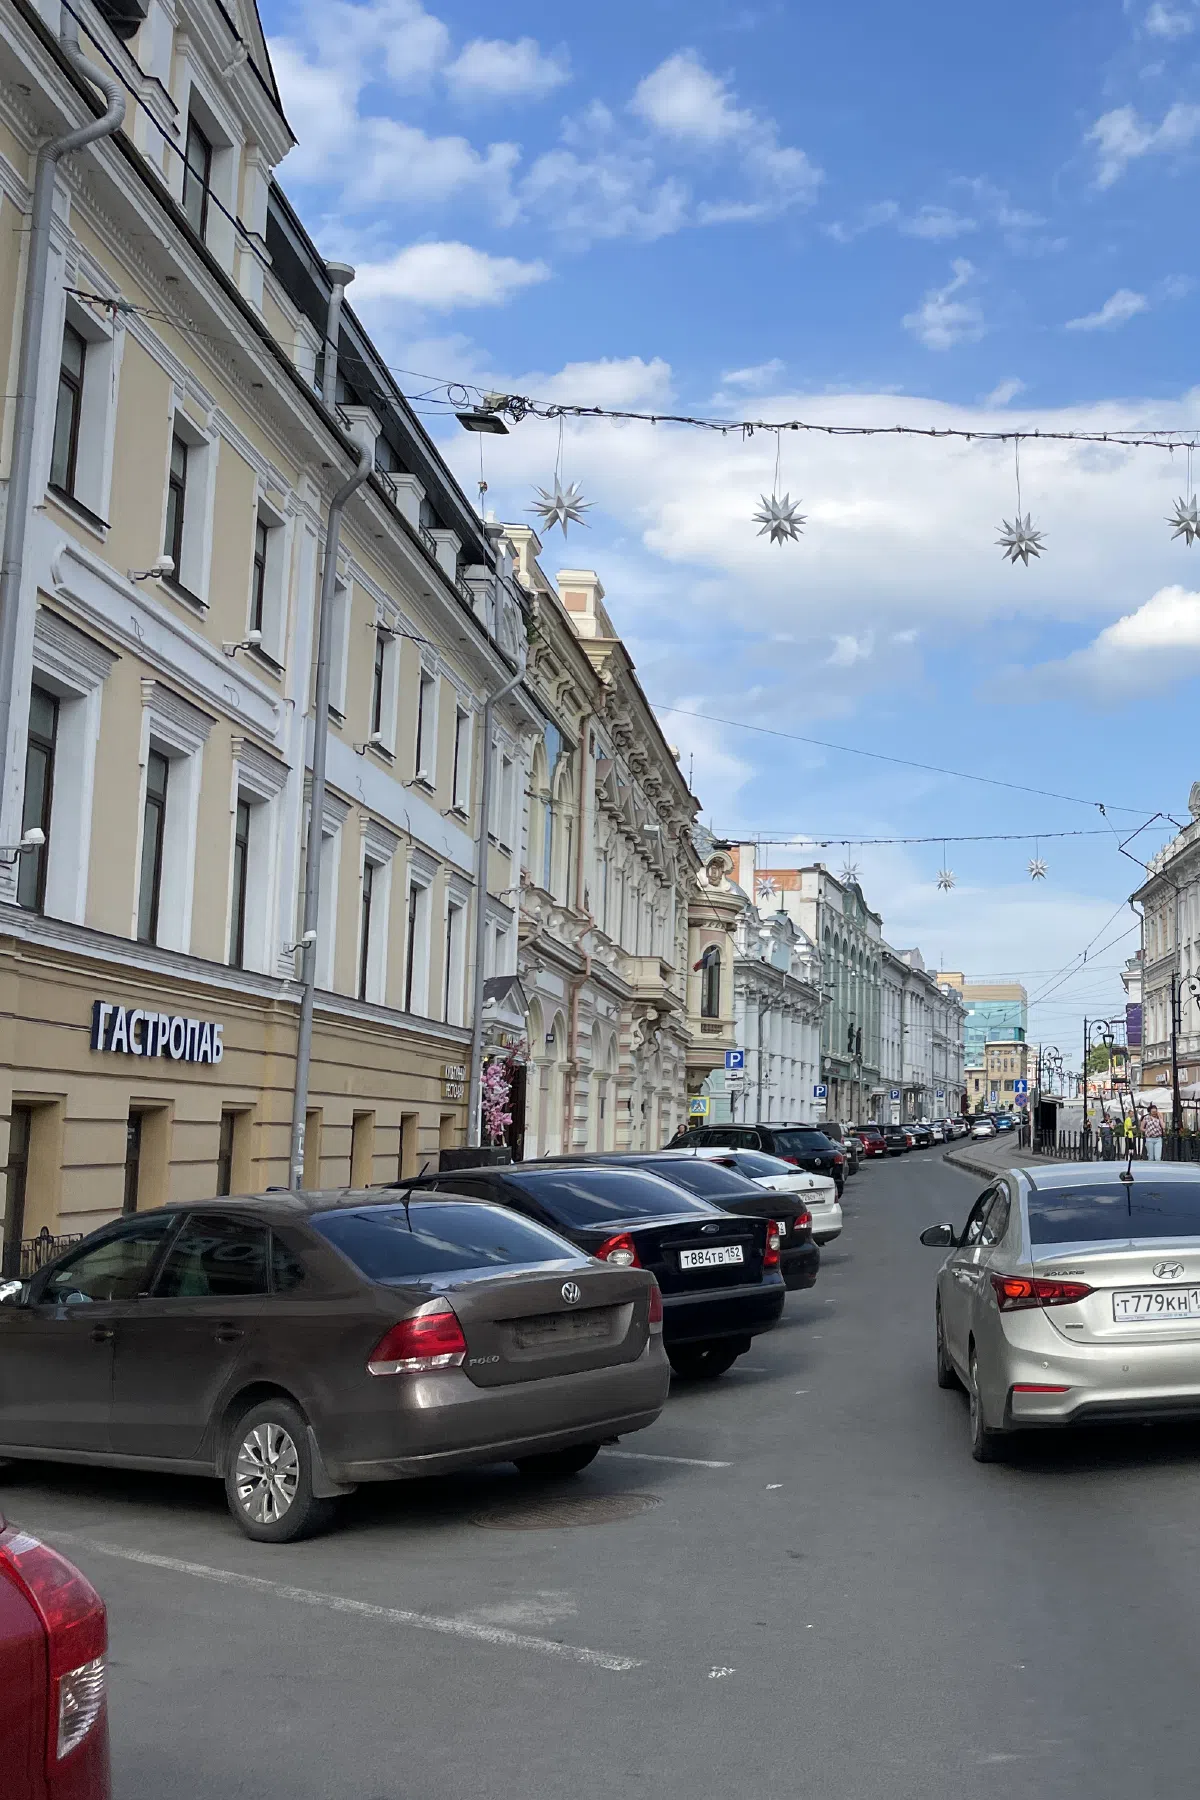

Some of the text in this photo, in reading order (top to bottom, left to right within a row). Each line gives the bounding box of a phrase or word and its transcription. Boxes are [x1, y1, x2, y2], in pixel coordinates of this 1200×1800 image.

[97, 1002, 224, 1064] ГАСТРОПАБ
[730, 1052, 741, 1067] P
[684, 1246, 741, 1266] Т884ТВ 152
[1120, 1293, 1188, 1313] Т779КН
